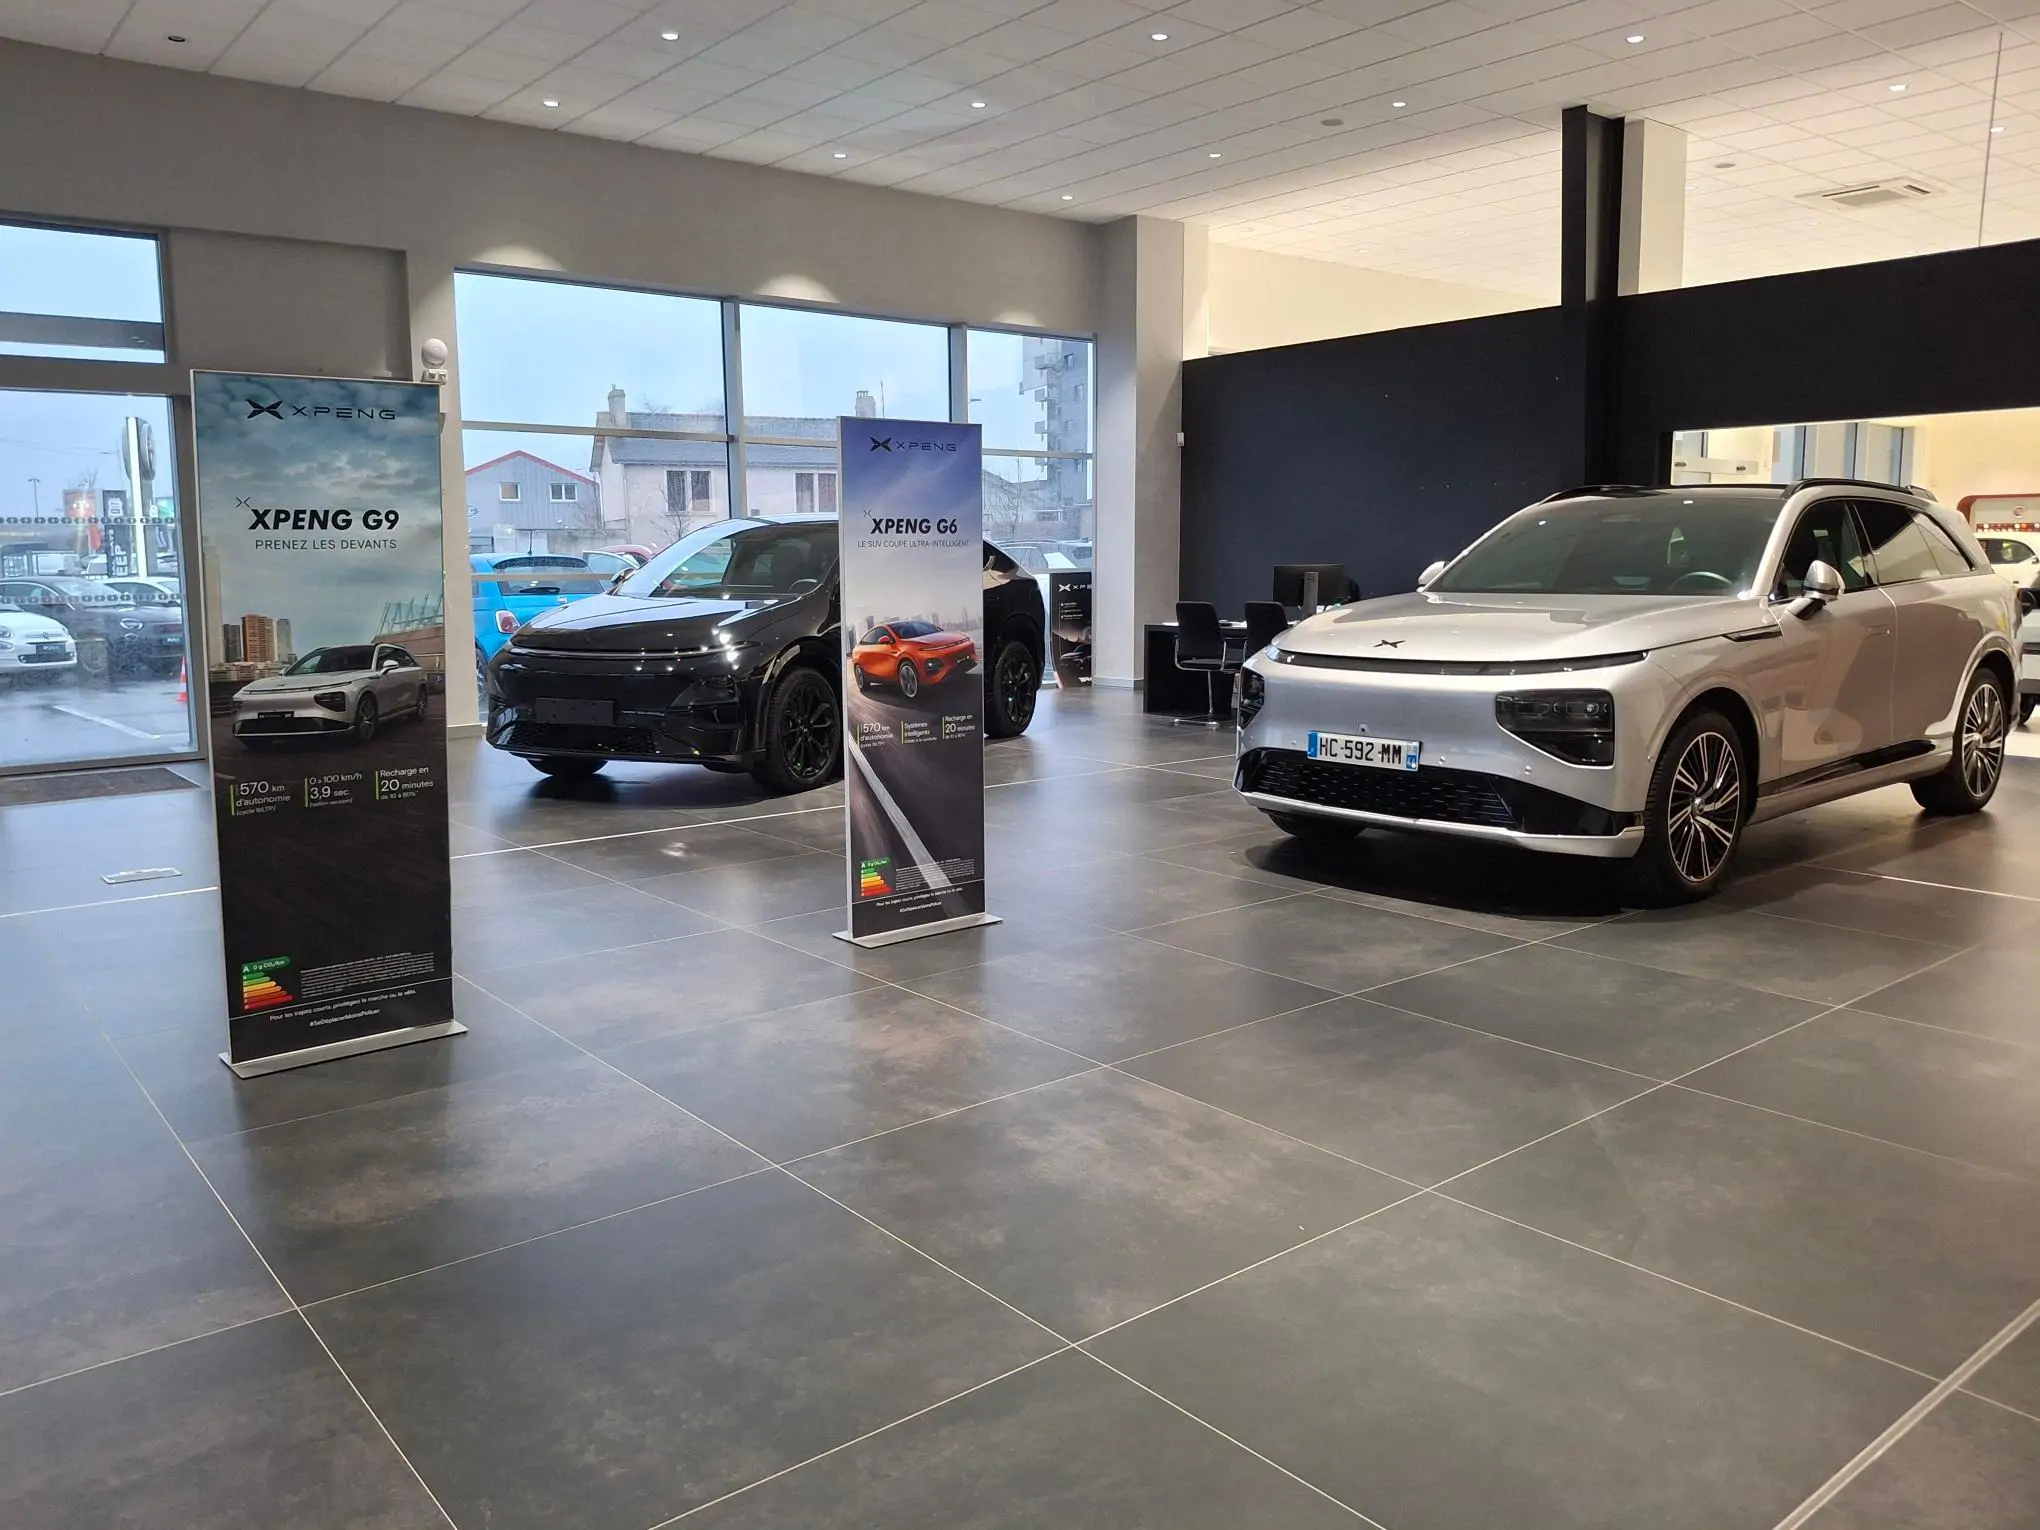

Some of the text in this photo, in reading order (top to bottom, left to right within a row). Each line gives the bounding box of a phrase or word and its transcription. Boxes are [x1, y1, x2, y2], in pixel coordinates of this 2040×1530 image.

[291, 404, 396, 420] XPENG
[896, 440, 957, 452] XPENG
[248, 509, 400, 531] XPENG G9
[870, 518, 958, 535] XPENG G6
[255, 539, 397, 550] PRENEZ LES DEVANTS
[857, 540, 866, 548] LE
[868, 540, 882, 548] SUV
[114, 544, 128, 577] EEP
[863, 722, 881, 733] 570
[945, 723, 957, 733] 20
[1319, 737, 1402, 765] HC-592-MM
[380, 766, 429, 777] Recharge en
[309, 776, 317, 785] 0
[323, 774, 340, 783] 100
[340, 772, 362, 781] km/h
[239, 781, 285, 796] 570 km
[310, 785, 331, 799] 3,9
[380, 779, 434, 792] 20 minutes
[235, 794, 291, 807] d'autonomie
[242, 965, 250, 973] A
